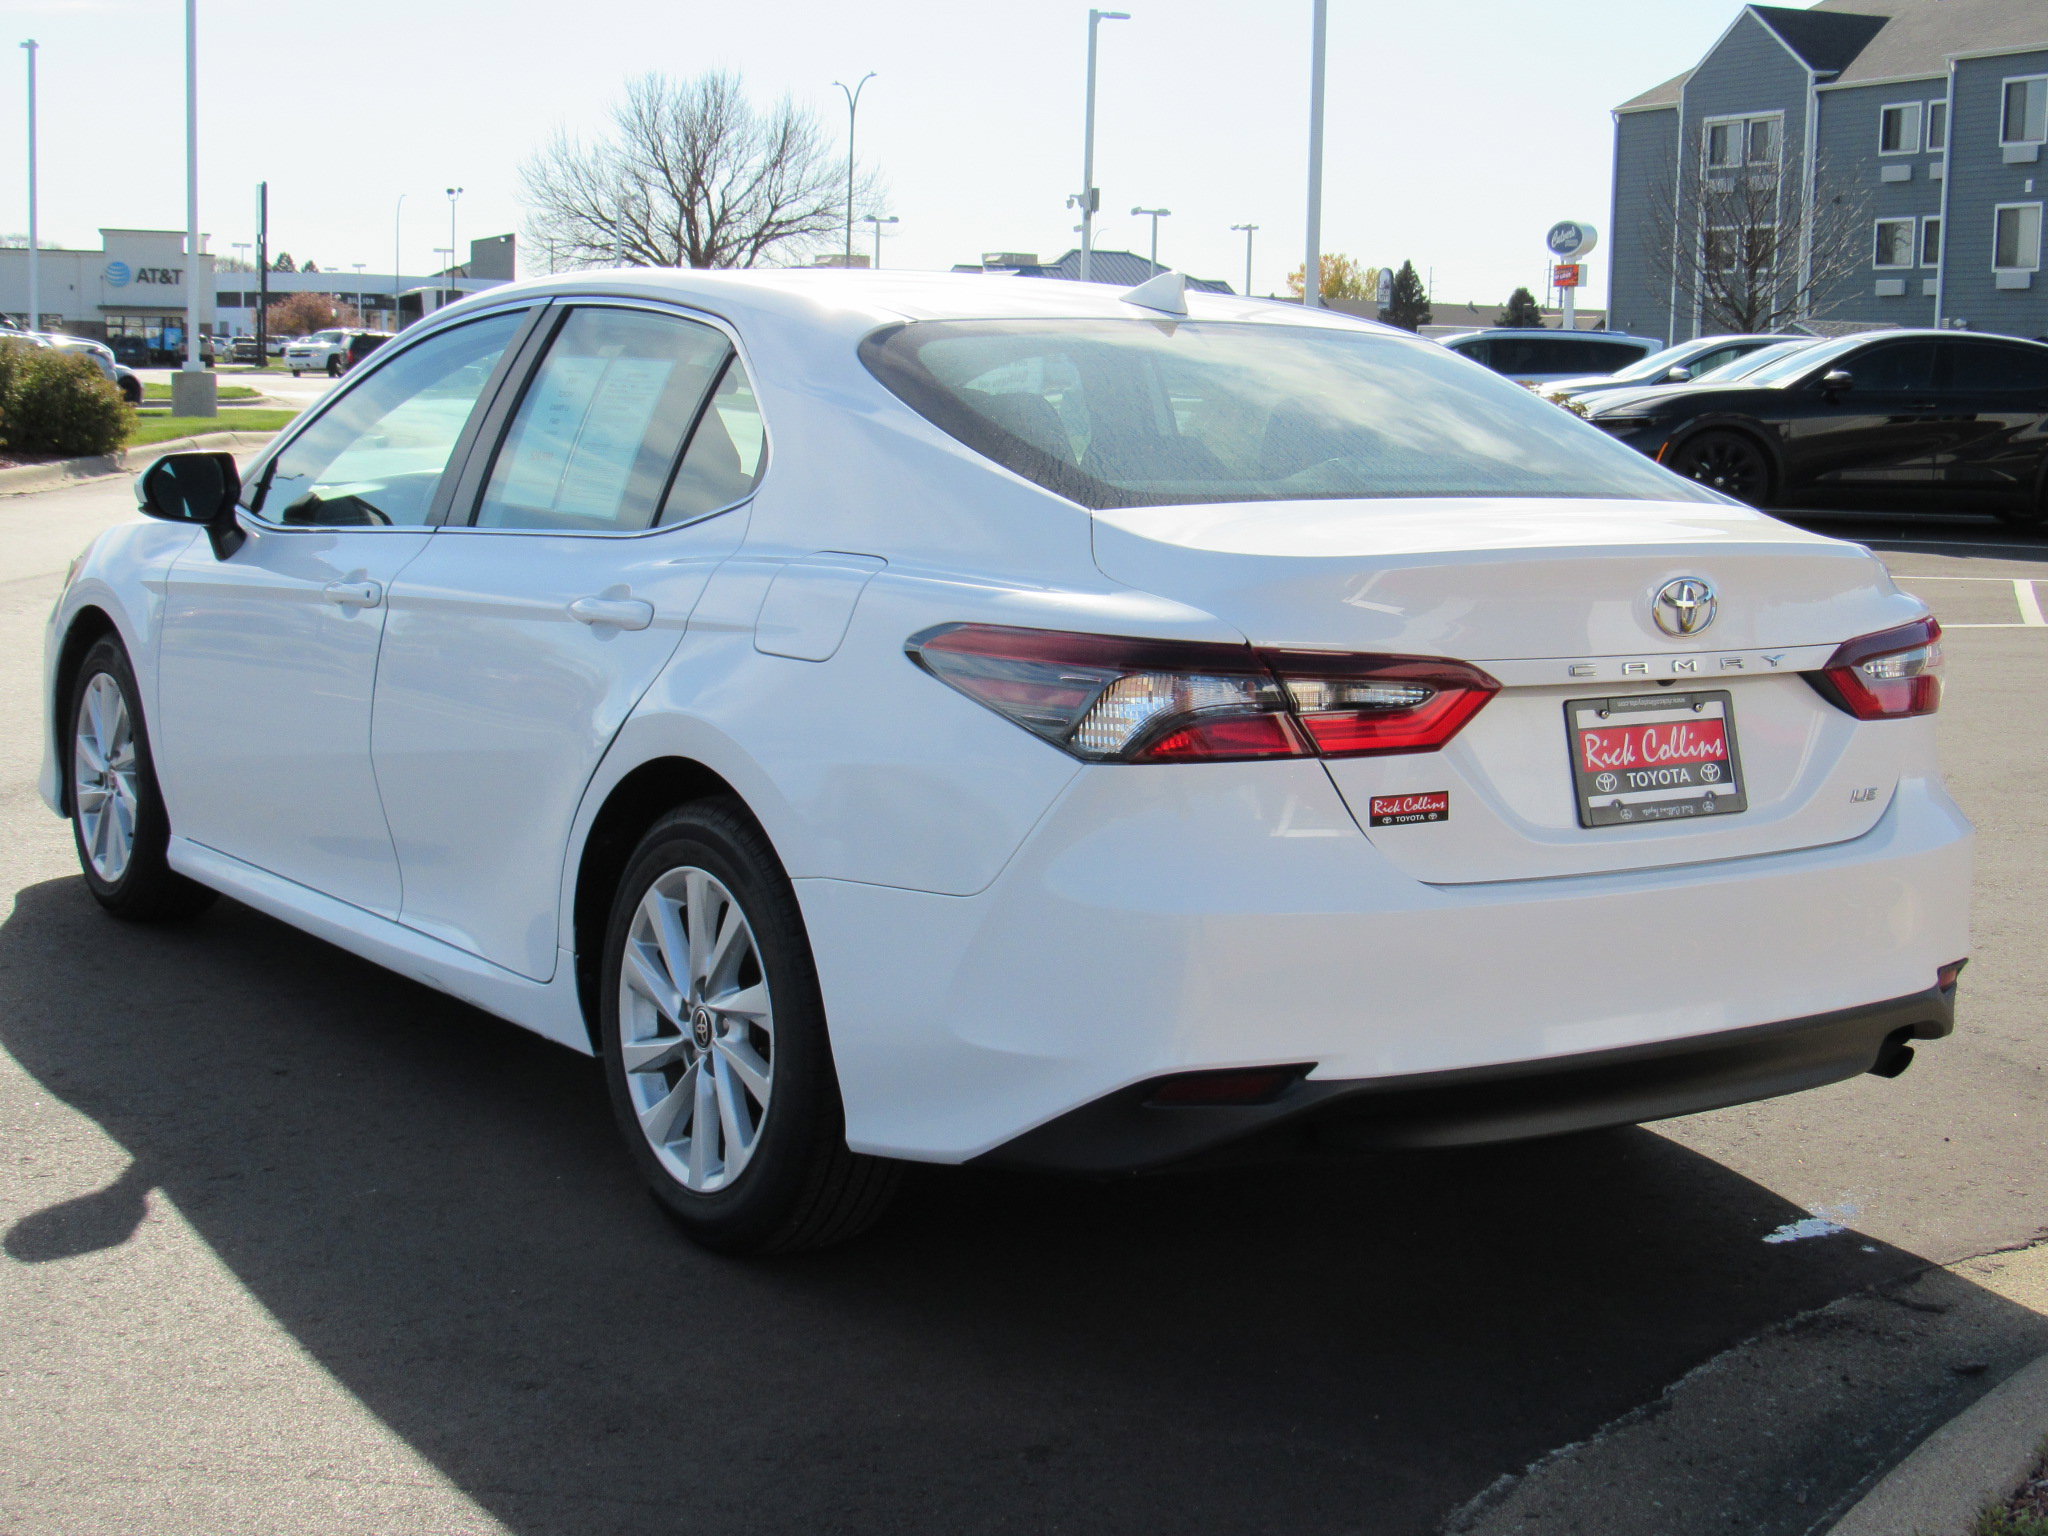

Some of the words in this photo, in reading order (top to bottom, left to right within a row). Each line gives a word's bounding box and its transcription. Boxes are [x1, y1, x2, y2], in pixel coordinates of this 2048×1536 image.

[136, 268, 184, 285] AT&T
[1568, 653, 1786, 678] CAMRY
[1584, 733, 1636, 769] Rick
[1641, 725, 1723, 763] Collins
[1626, 768, 1691, 788] TOYOTA
[1374, 799, 1401, 814] Rick
[1403, 796, 1445, 812] Collins
[1395, 814, 1425, 823] TOYOTA
